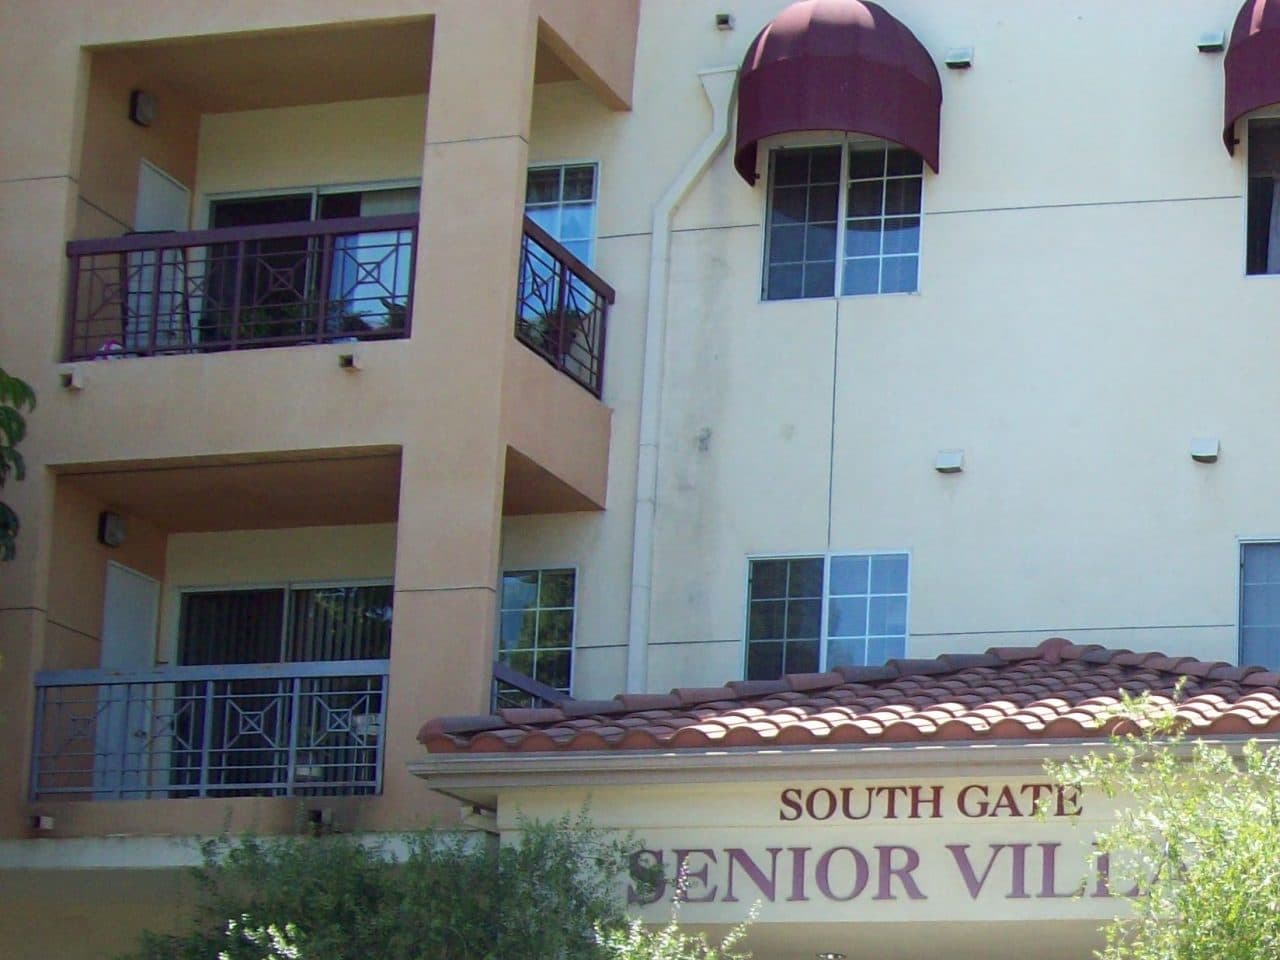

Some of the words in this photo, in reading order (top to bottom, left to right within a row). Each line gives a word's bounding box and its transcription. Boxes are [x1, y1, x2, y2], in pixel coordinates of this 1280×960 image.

[779, 784, 944, 821] SOUTH
[956, 782, 1084, 819] GATE
[626, 845, 928, 905] SENIOR
